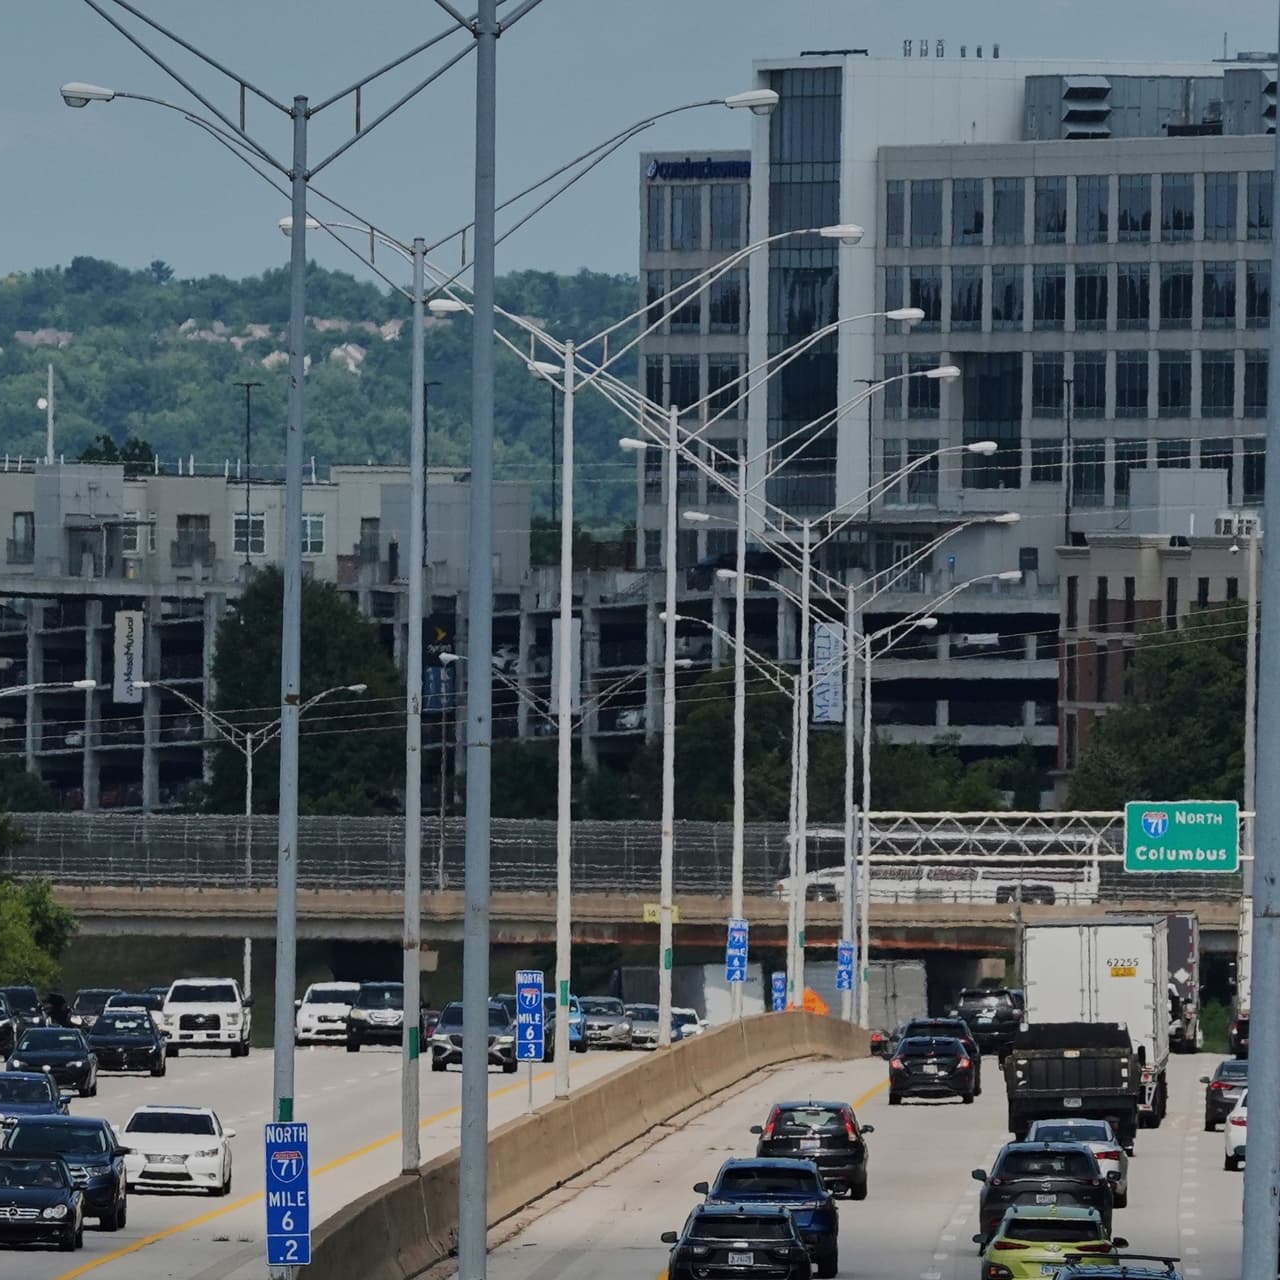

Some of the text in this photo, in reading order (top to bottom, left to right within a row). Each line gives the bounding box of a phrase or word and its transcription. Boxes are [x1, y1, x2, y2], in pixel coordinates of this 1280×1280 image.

[123, 616, 134, 682] MassMutual
[1148, 811, 1223, 834] 71 NORTH
[1135, 846, 1228, 861] Columbus
[517, 973, 542, 984] NORTH
[523, 994, 537, 1005] 71
[519, 1013, 542, 1025] MILE
[526, 1026, 535, 1040] 6
[524, 1044, 536, 1057] .3
[266, 1126, 307, 1143] NORTH
[277, 1159, 297, 1177] 71
[269, 1191, 306, 1207] MILE
[282, 1210, 294, 1231] 6
[280, 1239, 298, 1260] .2
